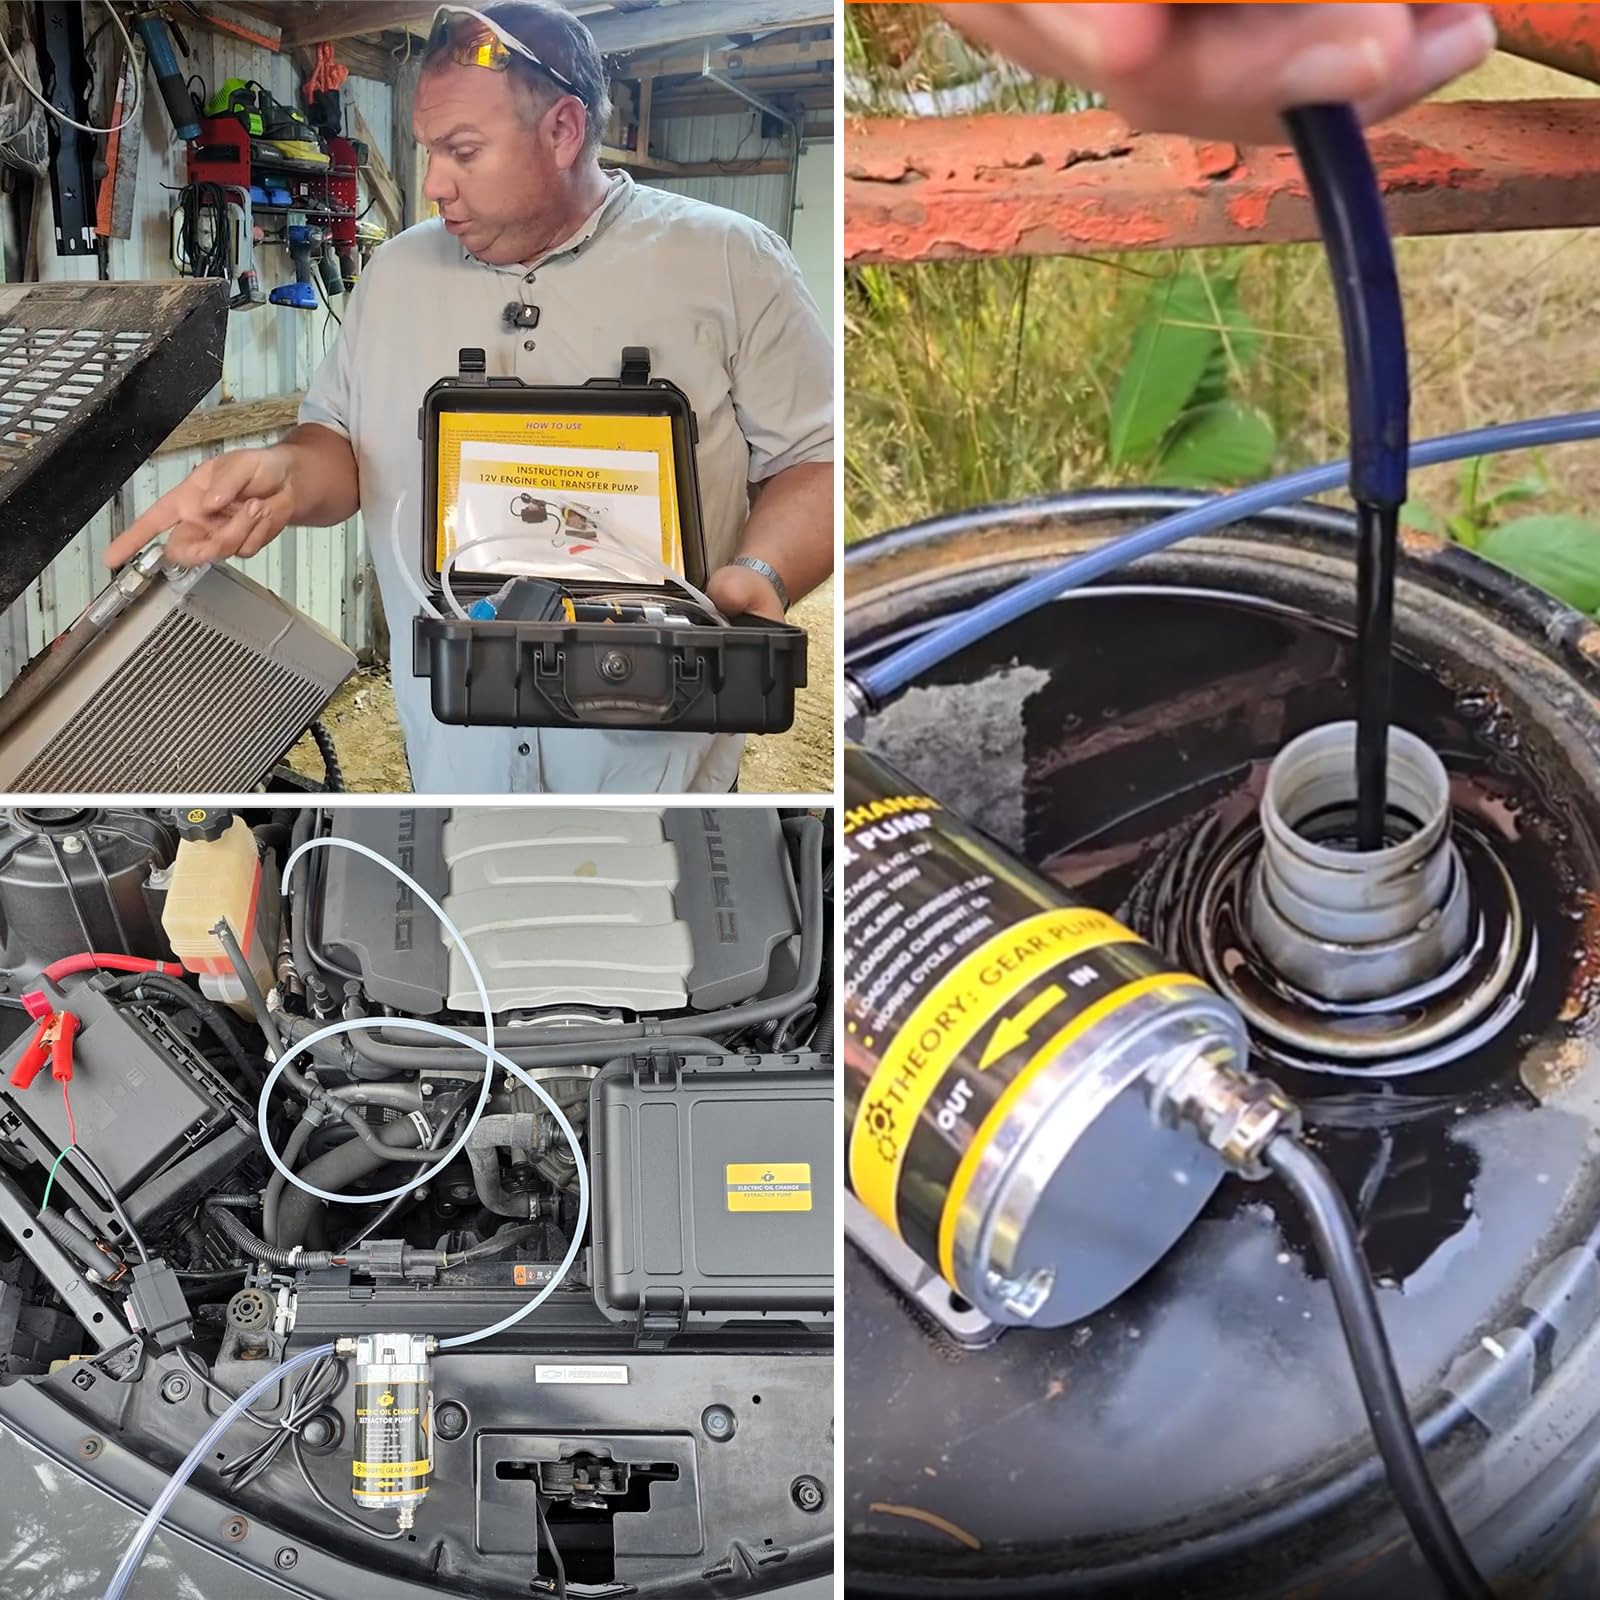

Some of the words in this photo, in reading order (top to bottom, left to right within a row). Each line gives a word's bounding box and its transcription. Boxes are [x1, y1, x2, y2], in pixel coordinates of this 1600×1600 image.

[525, 421, 550, 430] HOW
[551, 422, 563, 430] TO
[565, 422, 583, 431] USE
[480, 473, 497, 482] 12V
[500, 475, 537, 486] ENGINE
[541, 478, 557, 487] OIL
[560, 480, 609, 490] TRANSFER
[612, 482, 639, 493] PUMP
[516, 465, 583, 478] INSTRUCTION
[586, 470, 601, 479] OF
[855, 812, 933, 850] PUMP
[1067, 964, 1100, 988] IN
[885, 991, 979, 1105] THEORY:
[978, 934, 1049, 987] GEAR
[937, 1078, 975, 1131] OUT
